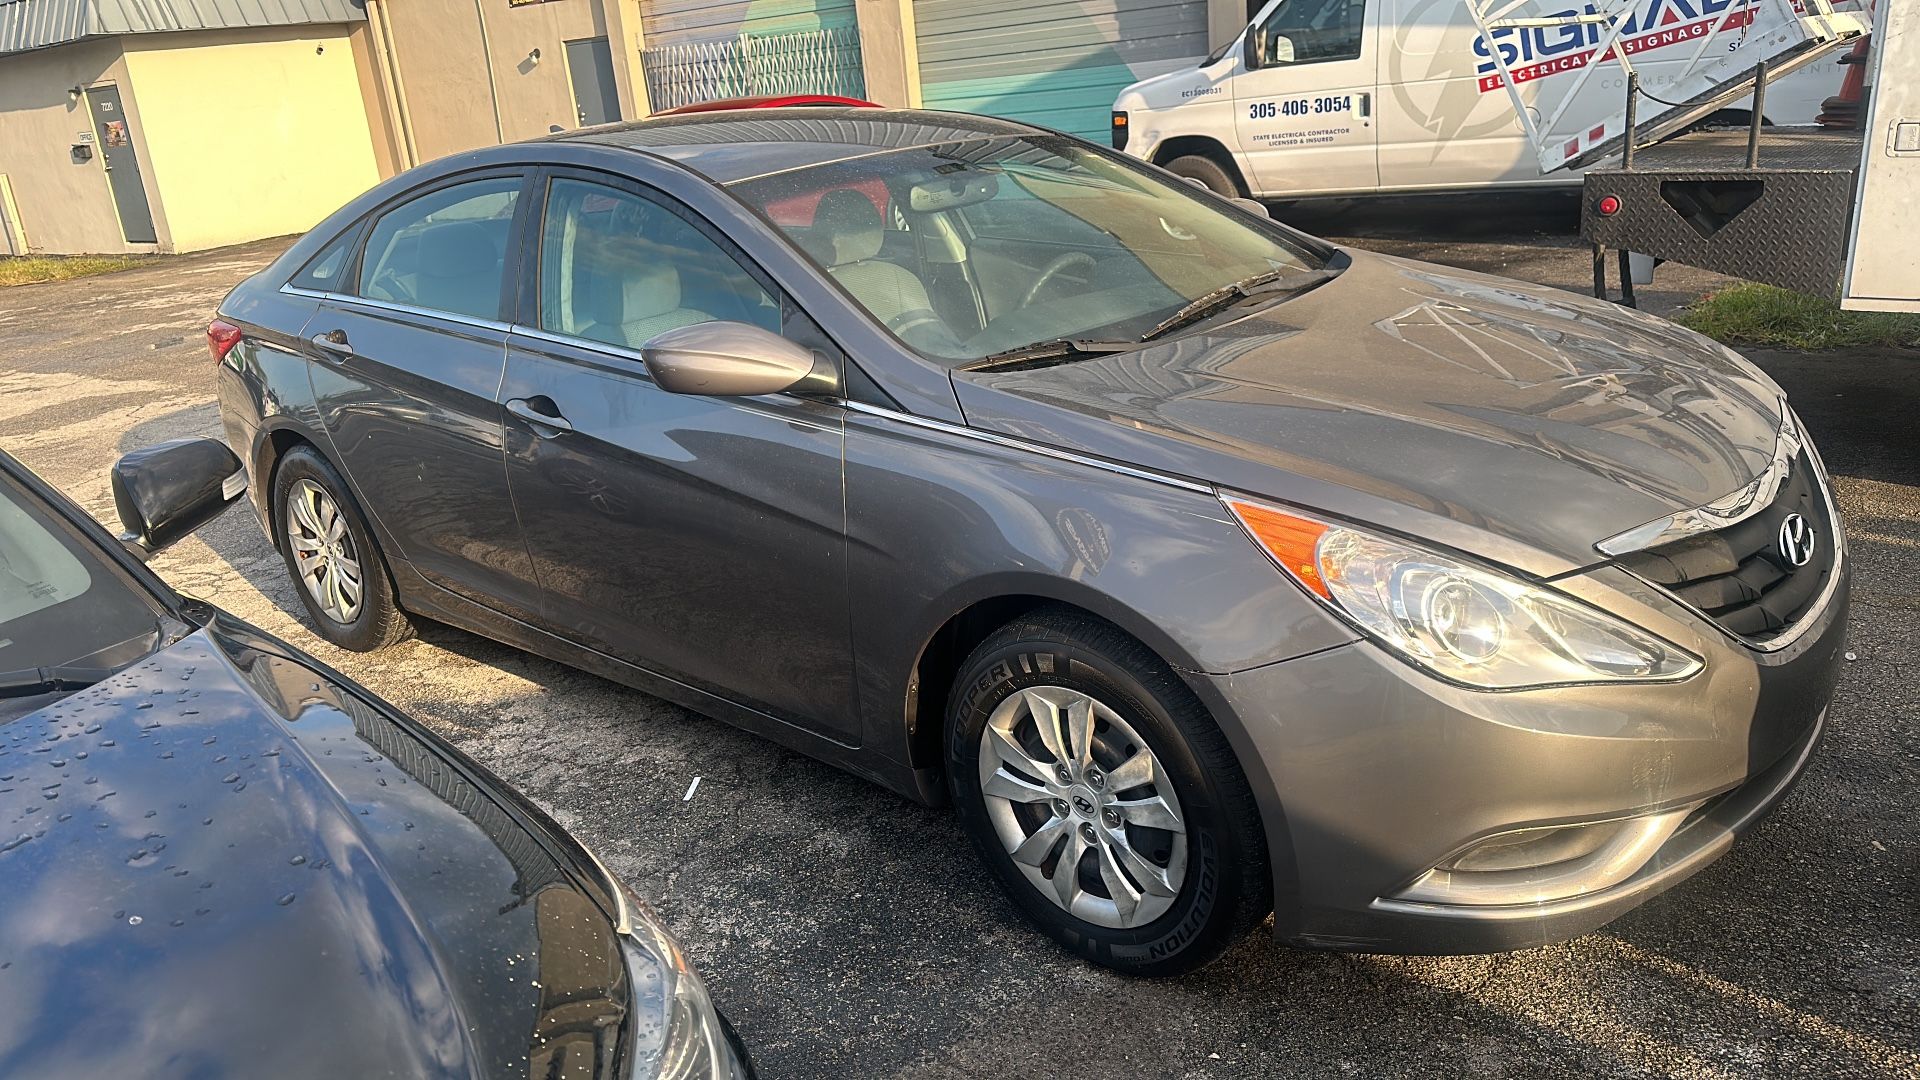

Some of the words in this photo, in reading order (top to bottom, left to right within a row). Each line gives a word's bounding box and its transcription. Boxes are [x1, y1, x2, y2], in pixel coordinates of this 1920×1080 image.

[1626, 21, 1715, 52] SIGNAGE
[1268, 139, 1298, 147] LICENSED
[1306, 136, 1334, 144] INSURED
[1271, 131, 1306, 140] ELECTRICAL
[1307, 128, 1350, 137] CONTRACTOR
[1148, 831, 1217, 960] EVOLUTION
